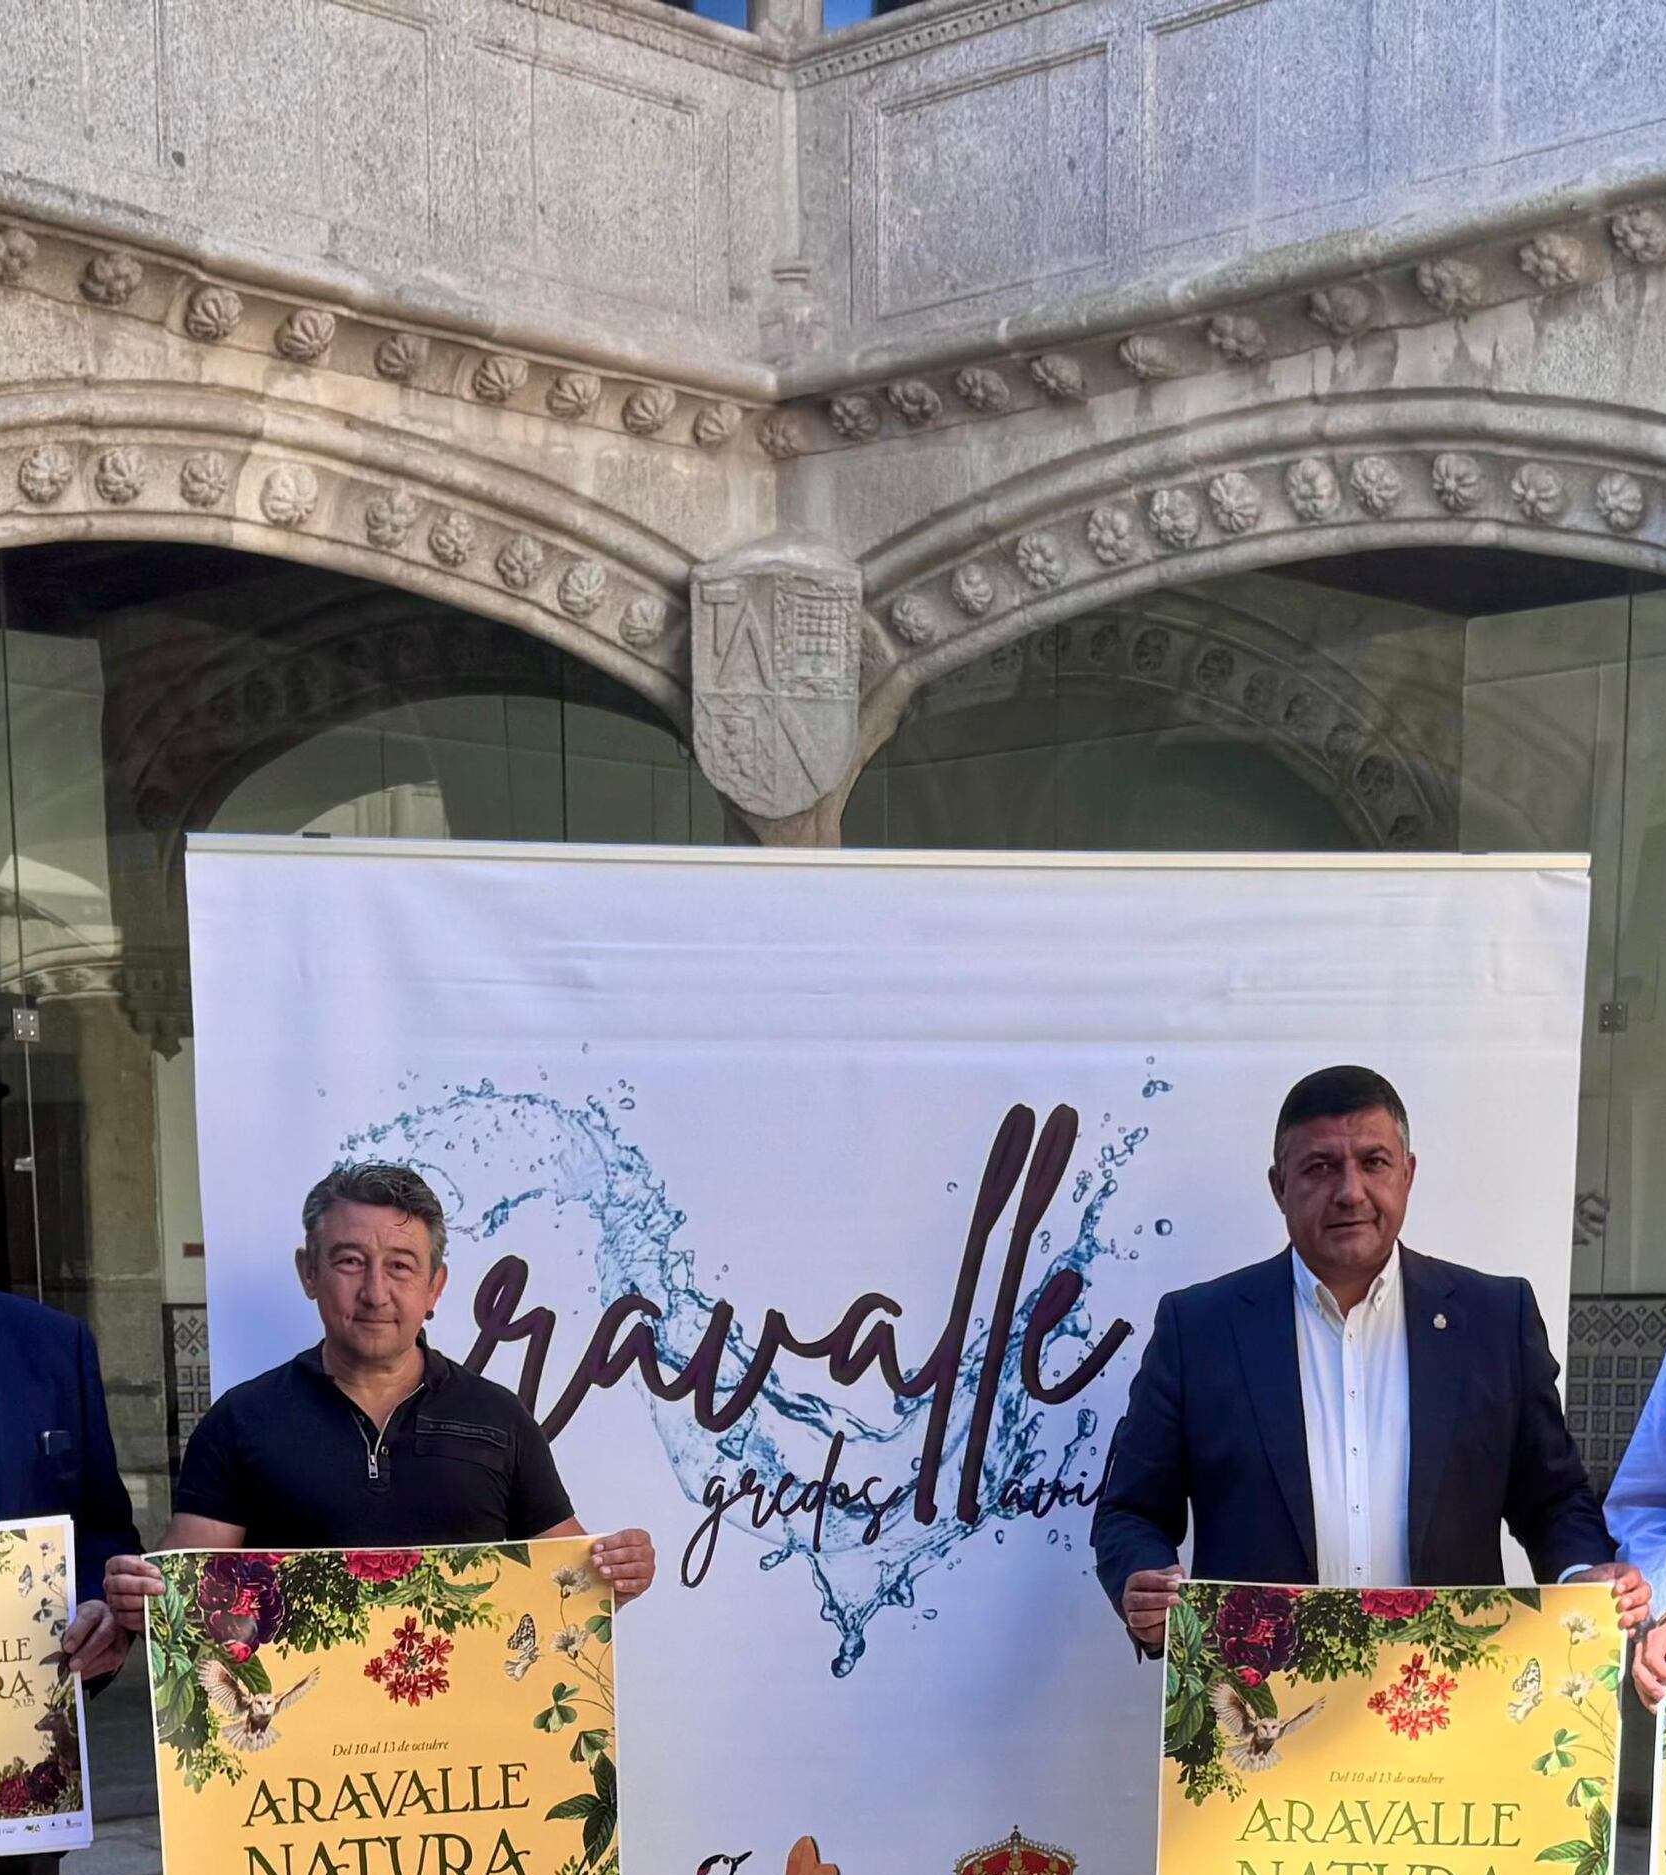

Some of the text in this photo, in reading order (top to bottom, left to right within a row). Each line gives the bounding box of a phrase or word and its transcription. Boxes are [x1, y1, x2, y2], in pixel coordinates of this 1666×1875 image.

[463, 1102, 1132, 1525] ravalle
[681, 1430, 903, 1588] gredos
[333, 1739, 449, 1757] Del 10 al 13 de octubre
[1329, 1770, 1350, 1783] Del
[1351, 1771, 1365, 1783] 10
[241, 1762, 530, 1828] ARAVALLE
[1237, 1798, 1522, 1848] ARAVALLE
